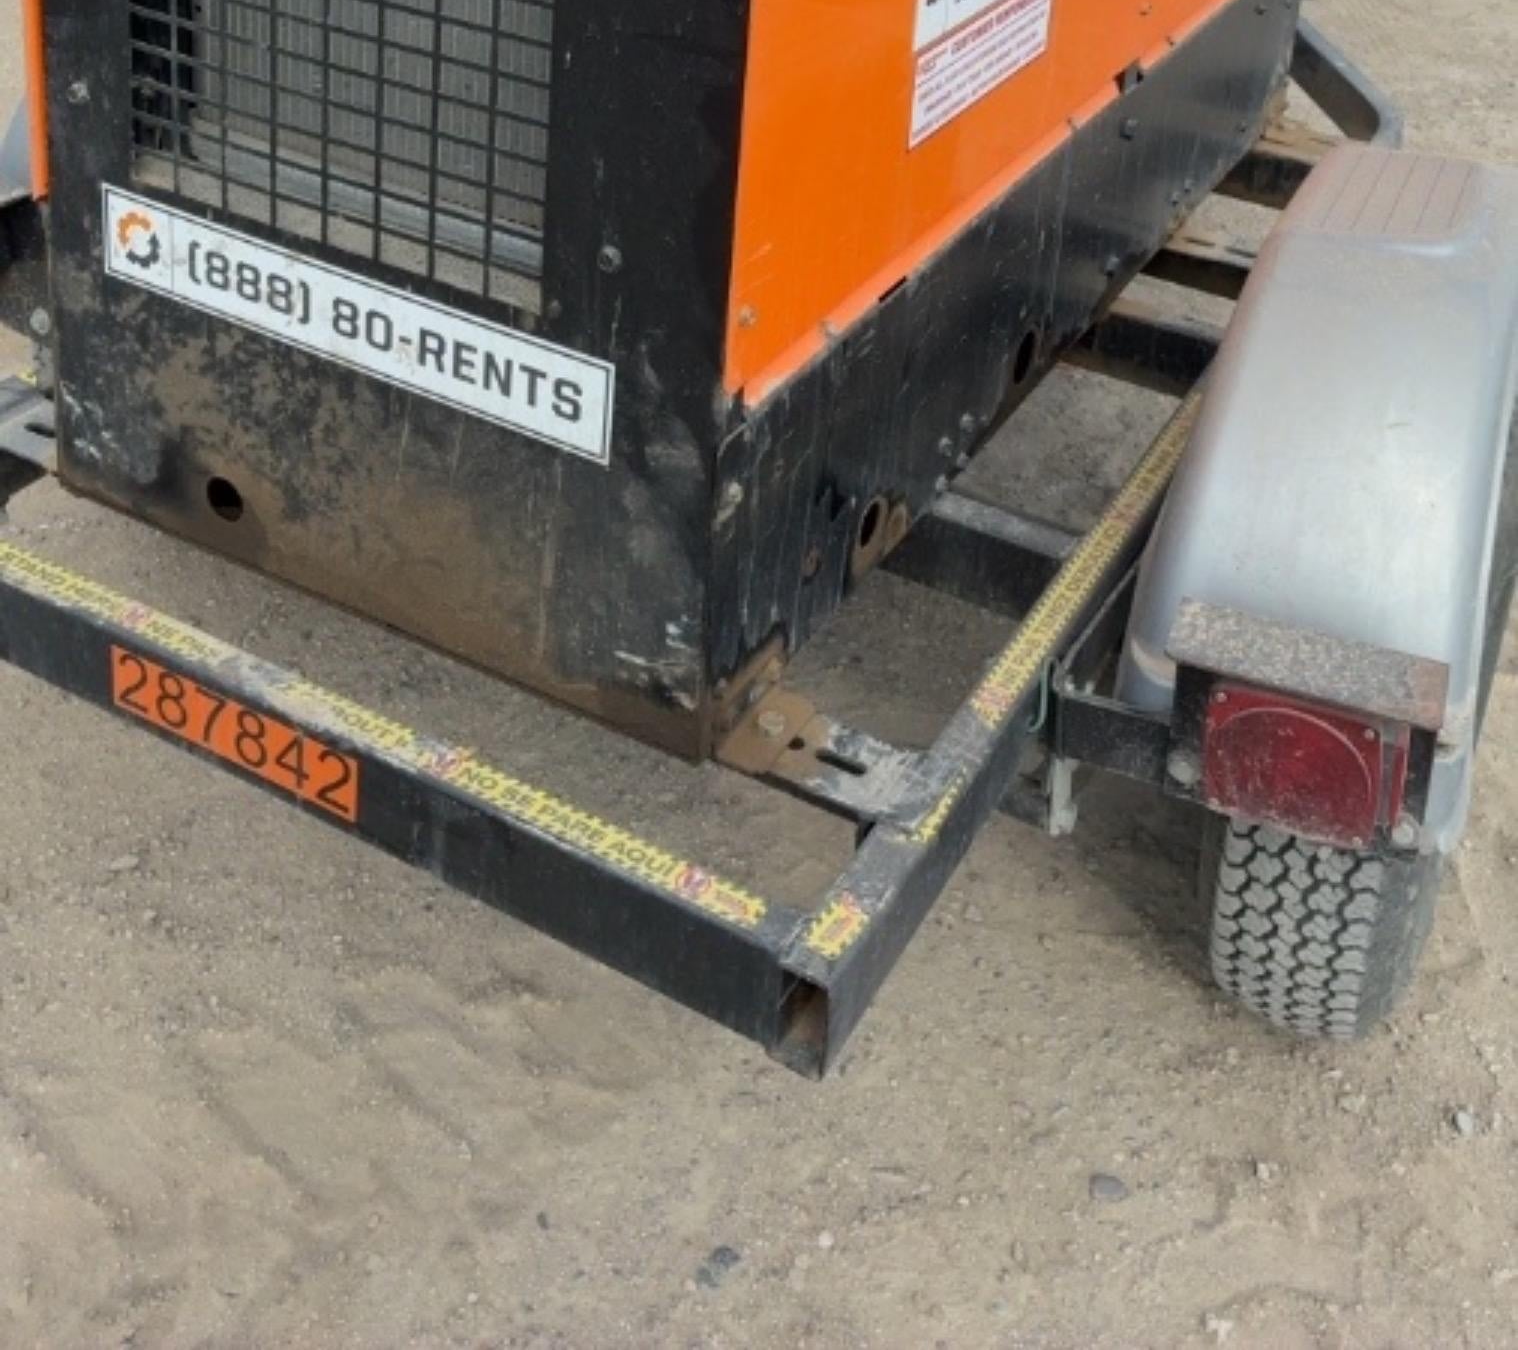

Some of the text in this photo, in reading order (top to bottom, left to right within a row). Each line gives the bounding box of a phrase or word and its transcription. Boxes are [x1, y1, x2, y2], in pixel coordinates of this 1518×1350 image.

[188, 240, 584, 424] (888) 80-RENTS
[118, 653, 352, 814] 287842
[459, 766, 499, 791] NO
